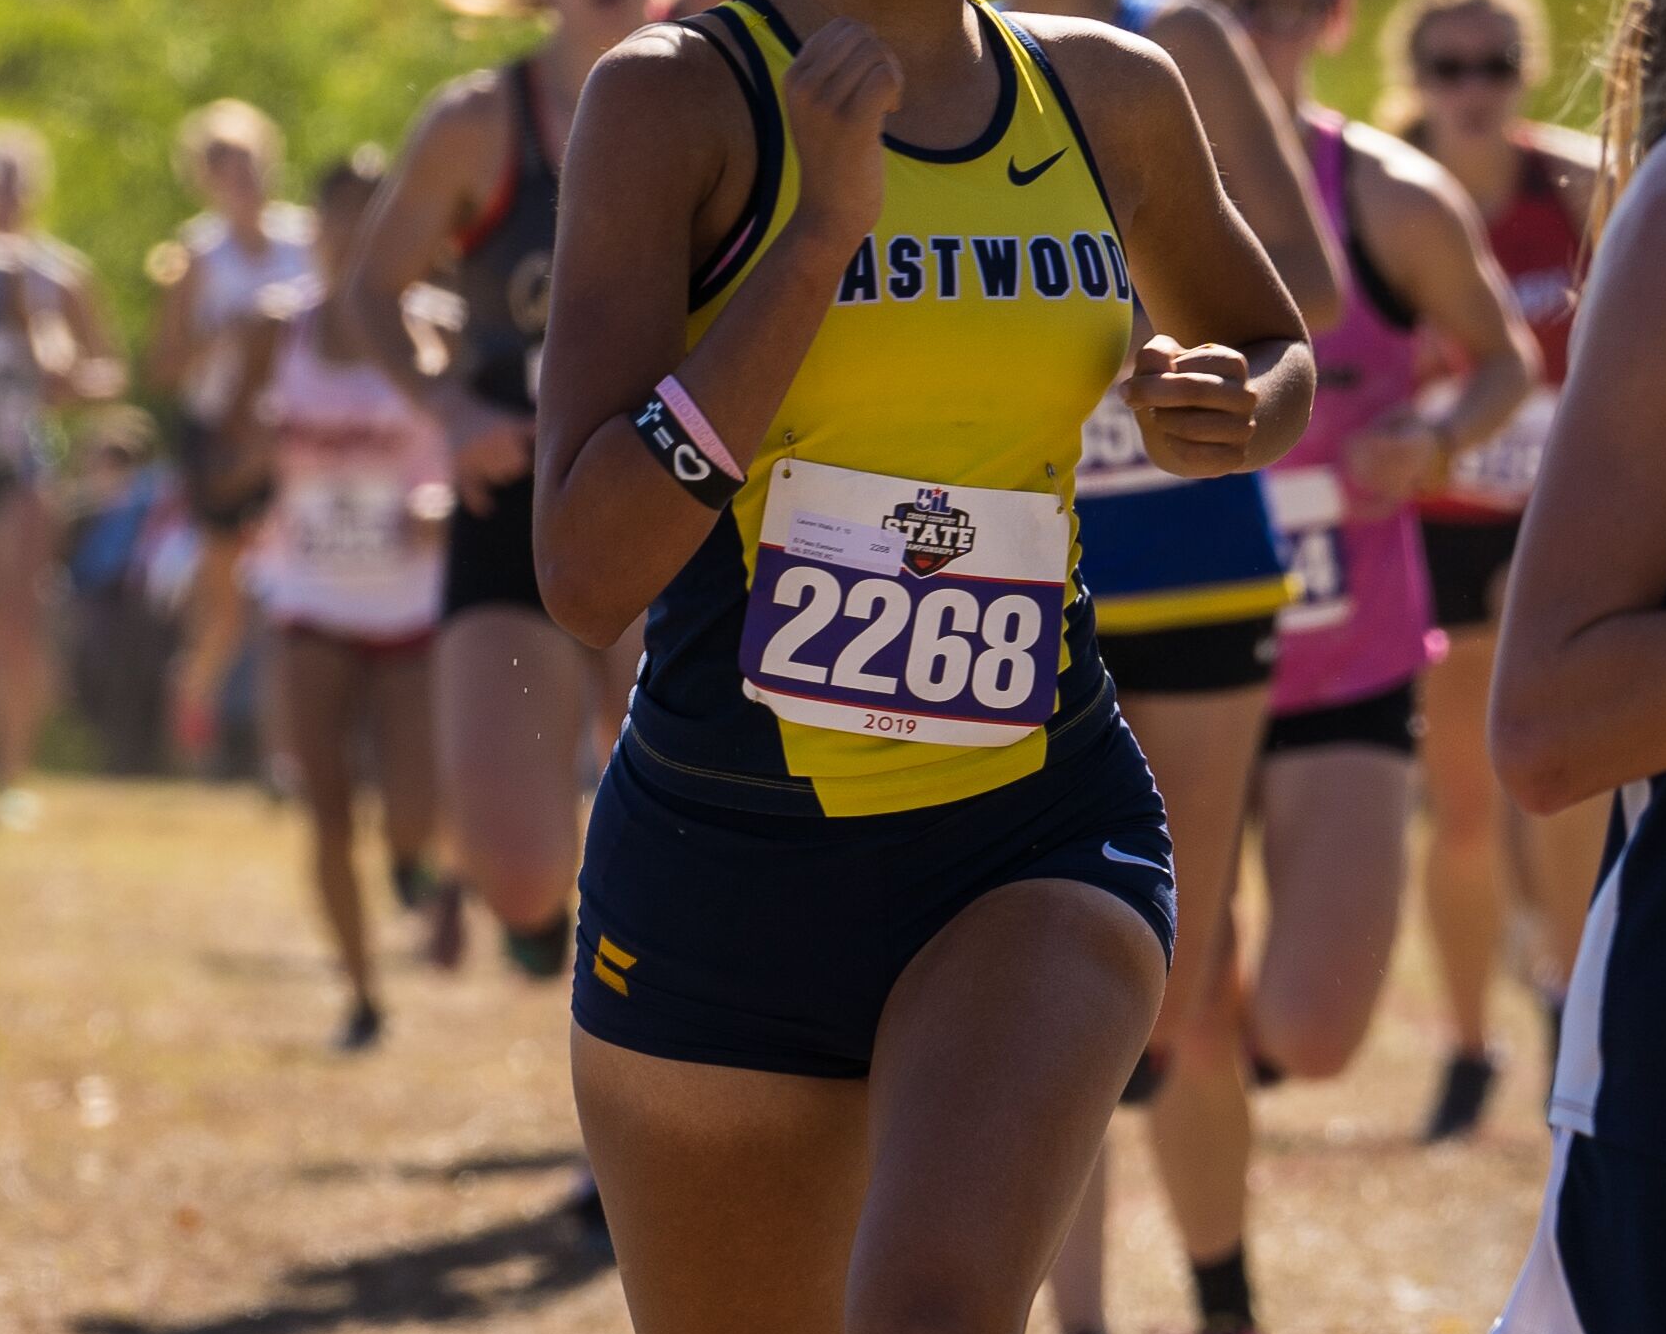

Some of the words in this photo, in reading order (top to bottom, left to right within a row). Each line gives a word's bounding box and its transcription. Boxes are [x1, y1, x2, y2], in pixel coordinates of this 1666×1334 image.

[833, 229, 1132, 307] ASTWOOD
[884, 517, 974, 548] STATE
[760, 566, 1042, 709] 2268
[863, 713, 917, 735] 2019
